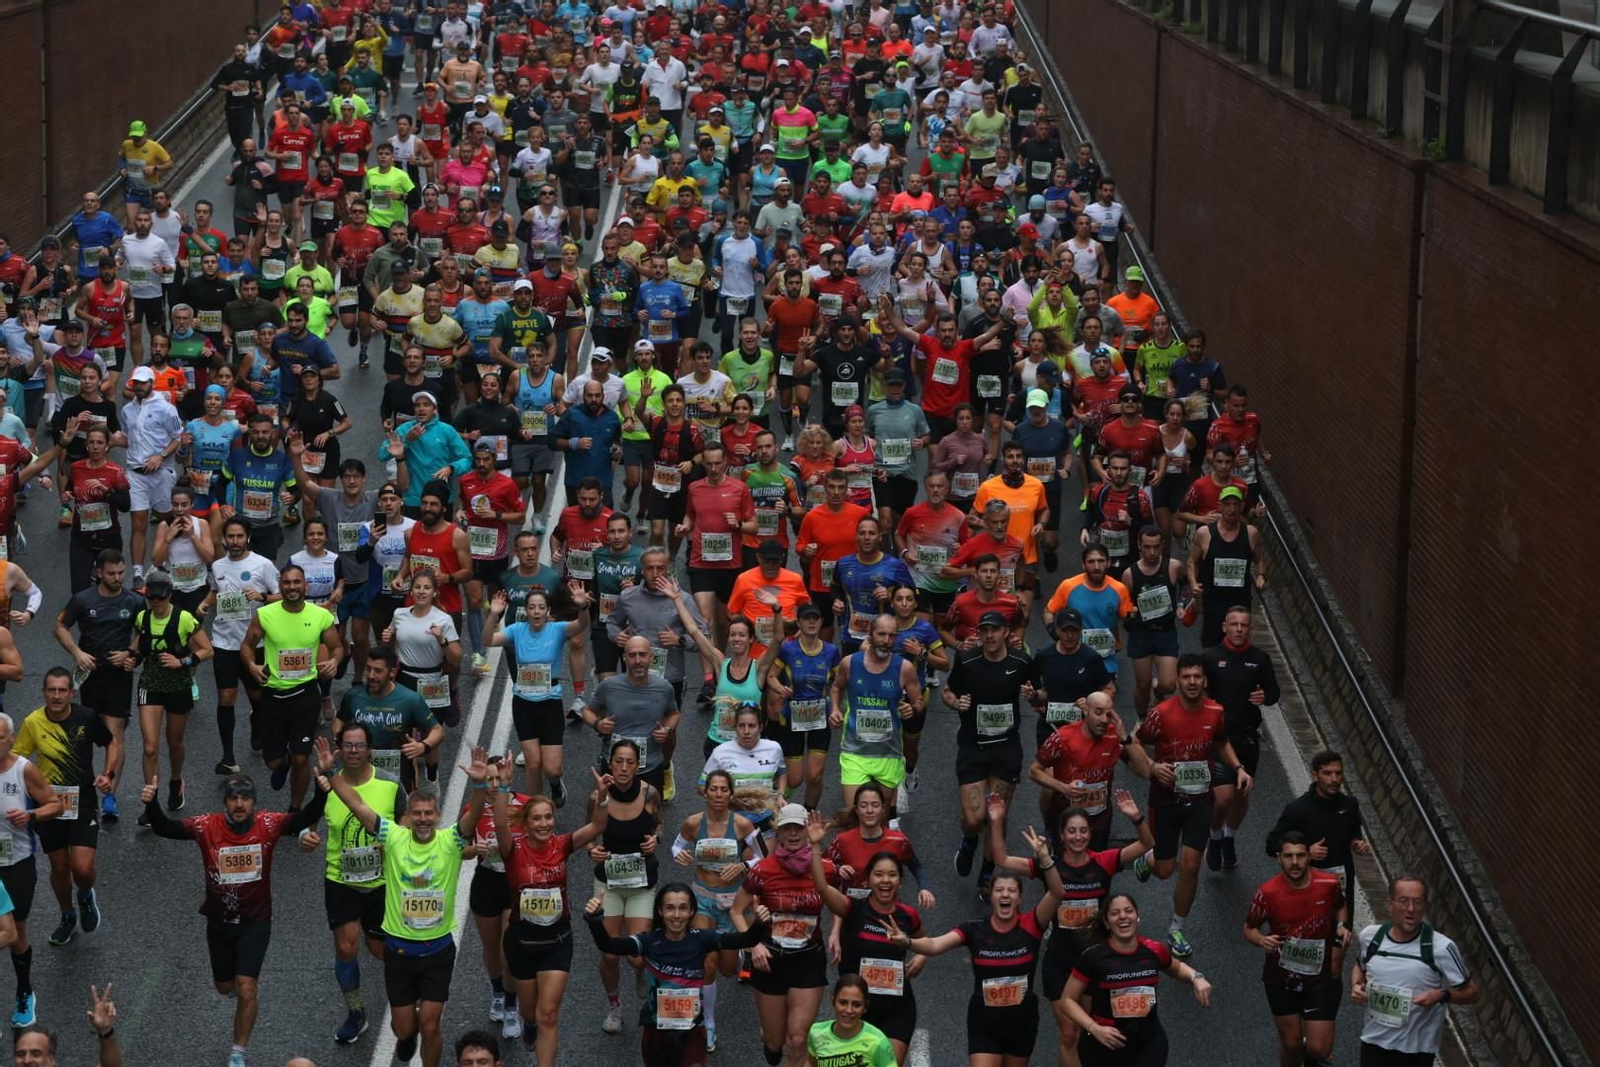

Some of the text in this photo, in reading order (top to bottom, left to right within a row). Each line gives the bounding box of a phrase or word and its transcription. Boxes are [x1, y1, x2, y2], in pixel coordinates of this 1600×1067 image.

[243, 478, 275, 490] TUSSAM
[704, 539, 728, 549] 10258
[221, 598, 242, 609] 6881
[284, 656, 306, 666] 5361
[859, 717, 888, 728] 10402
[982, 712, 1006, 723] 9499
[1179, 770, 1206, 781] 10336
[225, 854, 253, 867] 5388
[345, 854, 376, 869] 10119
[608, 861, 641, 875] 10436
[404, 899, 438, 912] 15170
[524, 898, 557, 911] 15171
[867, 969, 895, 982] 4730
[1106, 969, 1158, 981] PRORUNNERS
[989, 986, 1018, 1000] 6197
[663, 999, 692, 1012] 5159
[1117, 996, 1147, 1010] 6198
[1373, 992, 1400, 1010] 7470
